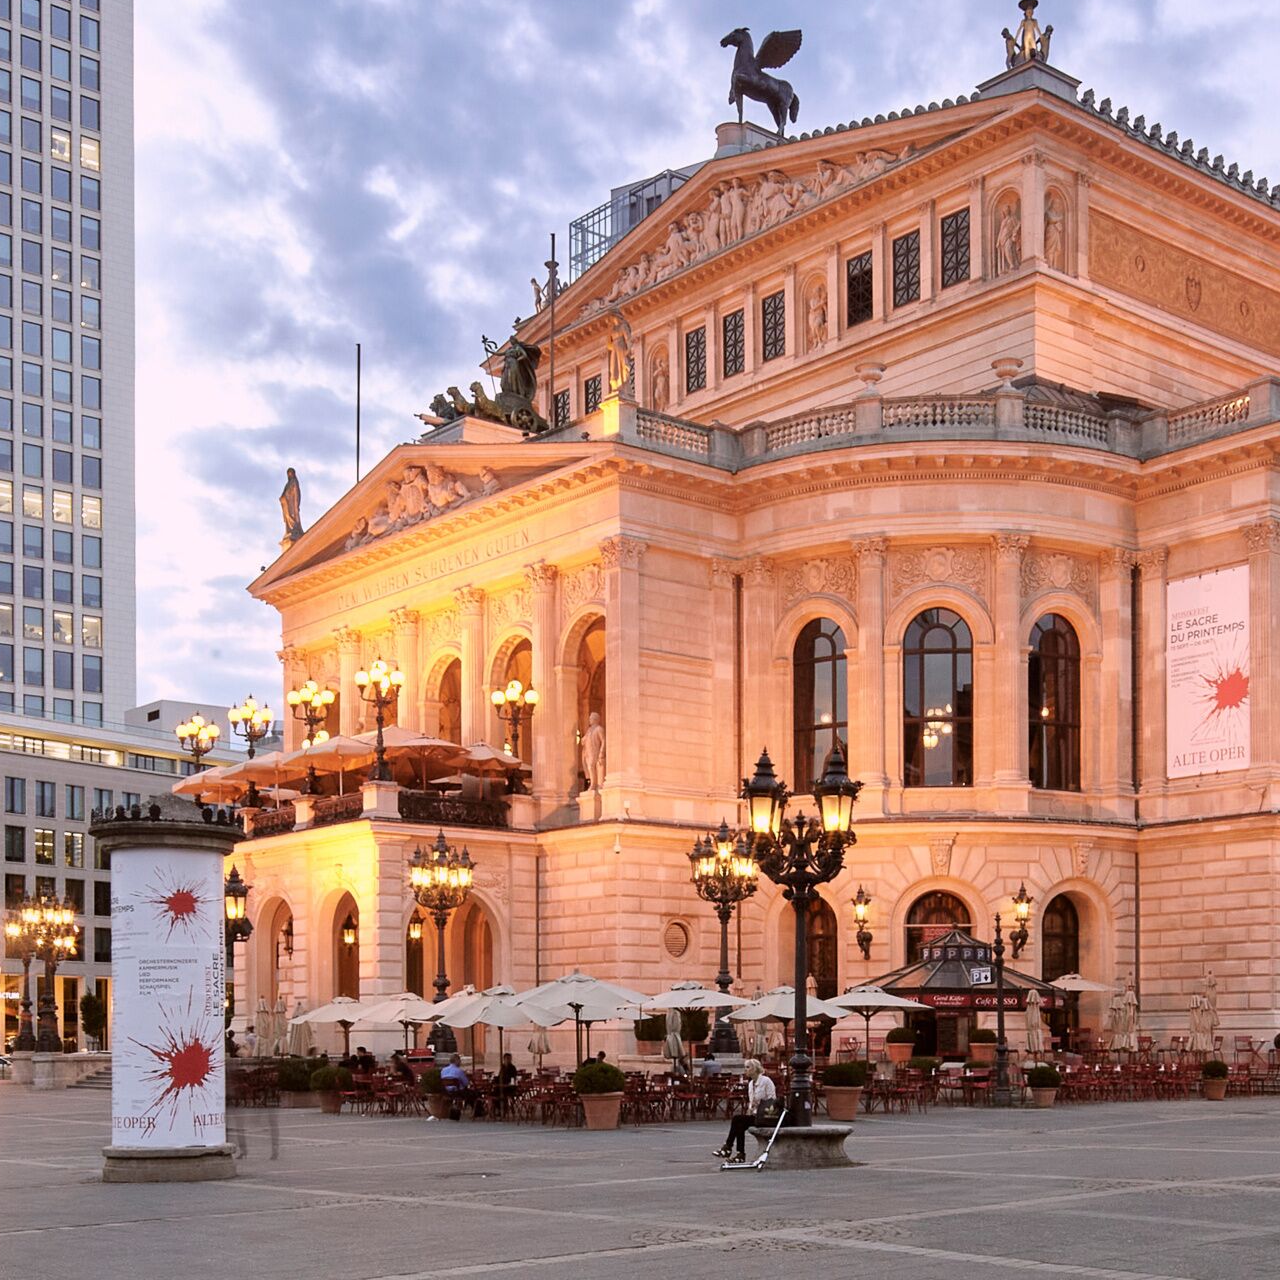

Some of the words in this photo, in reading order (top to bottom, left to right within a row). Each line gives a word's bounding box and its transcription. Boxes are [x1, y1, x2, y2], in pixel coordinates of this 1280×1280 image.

[415, 547, 480, 582] SCHOENEN
[1171, 621, 1183, 632] LE
[1185, 614, 1219, 629] SACRE
[1170, 633, 1185, 644] DU
[1187, 621, 1245, 641] PRINTEMPS
[1173, 751, 1207, 768] ALTE
[1209, 746, 1245, 762] OPER
[973, 972, 980, 982] P
[992, 997, 1018, 1005] RSSO
[212, 1003, 219, 1017] LE
[123, 1116, 156, 1129] OPER
[193, 1112, 220, 1127] ALTE
